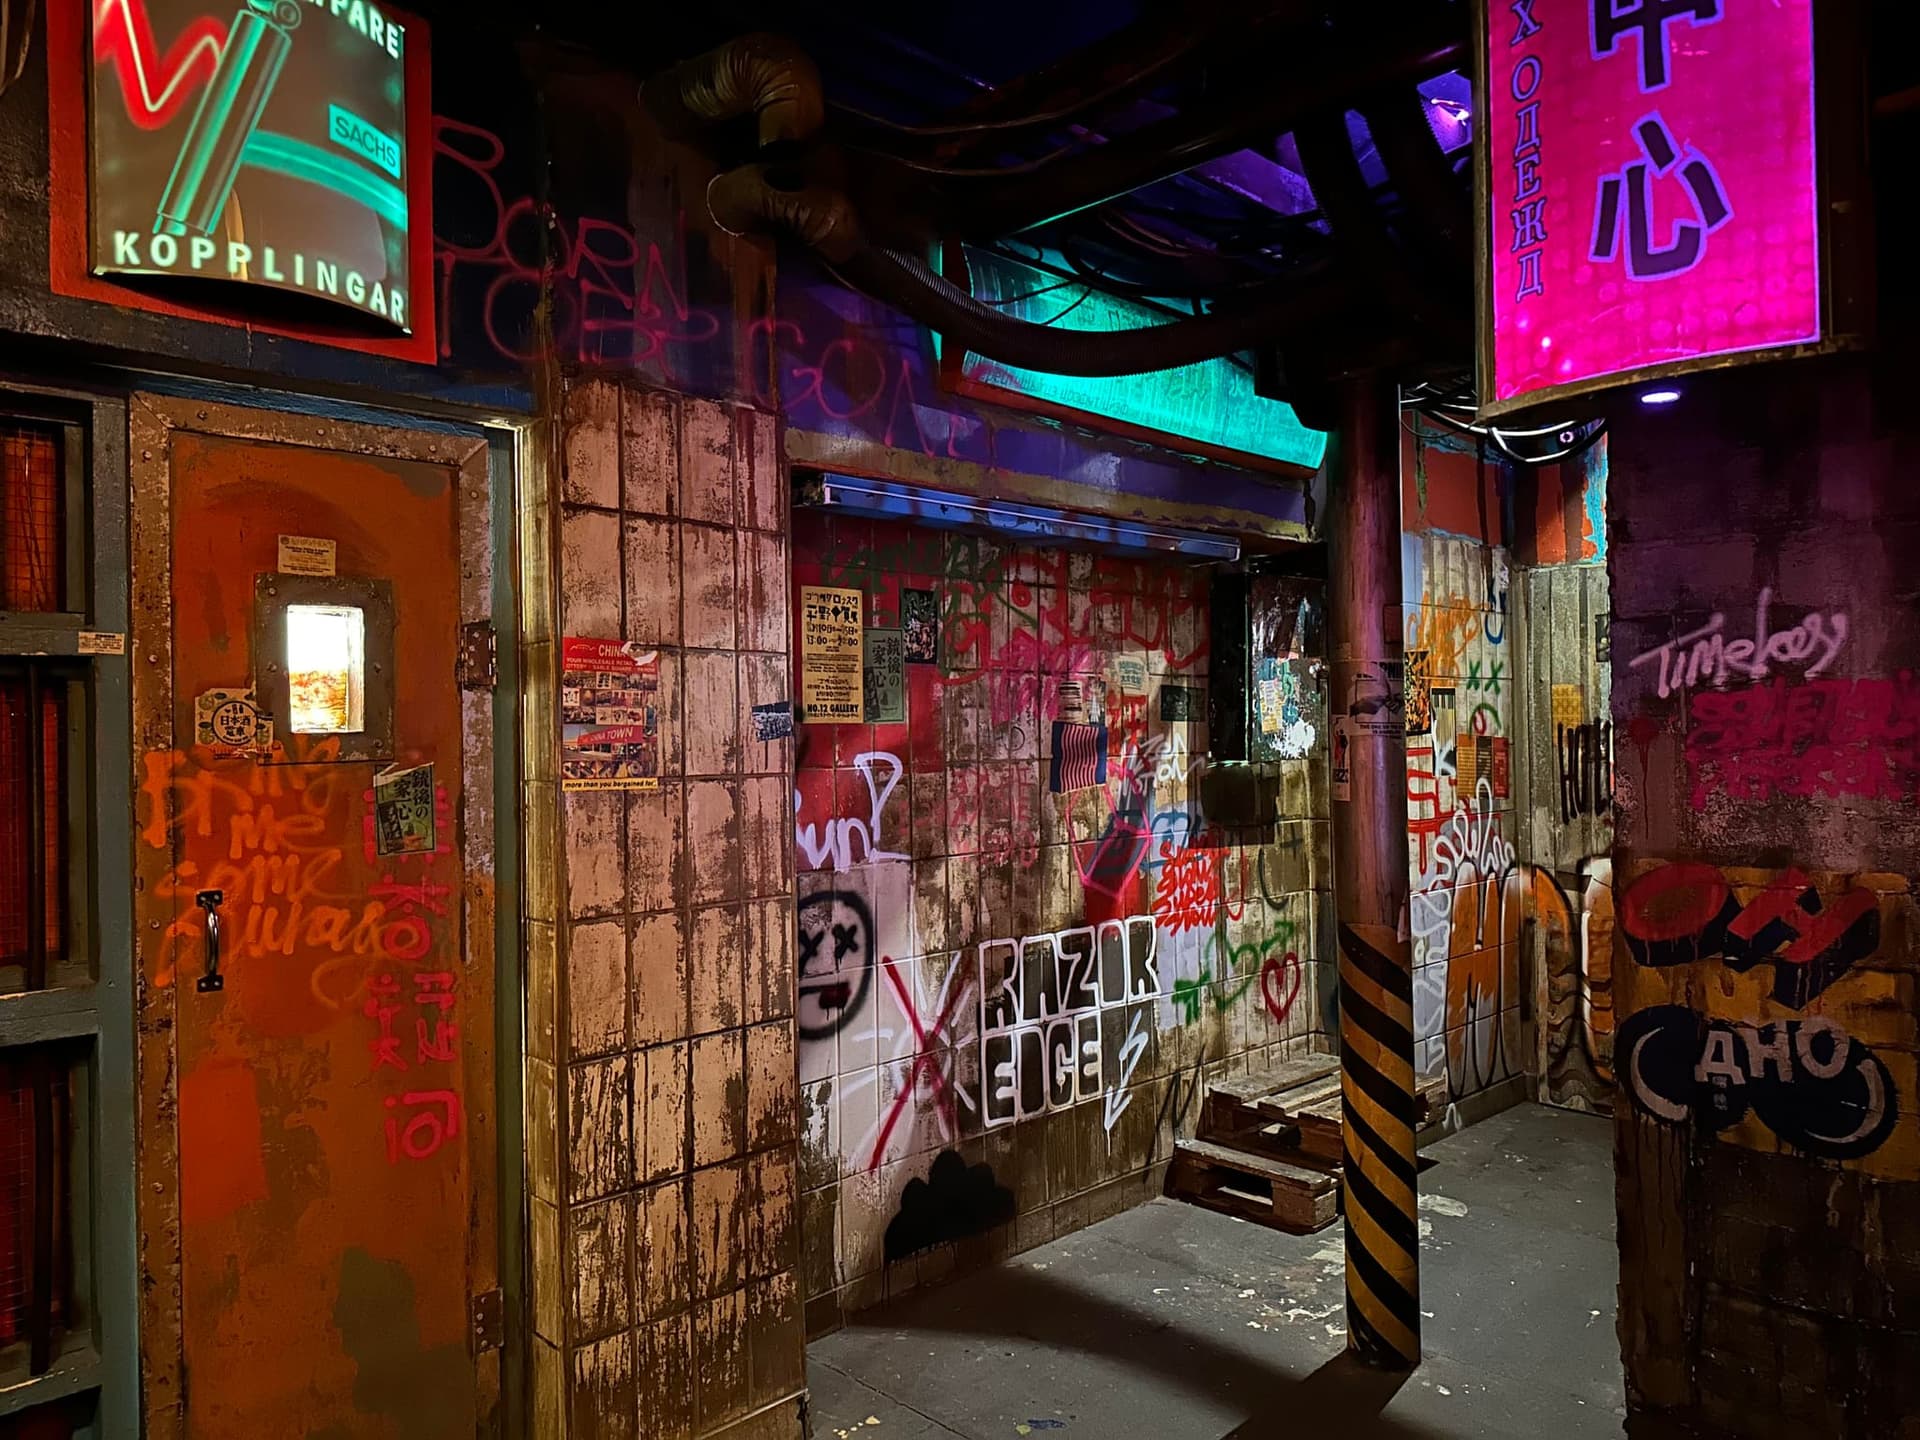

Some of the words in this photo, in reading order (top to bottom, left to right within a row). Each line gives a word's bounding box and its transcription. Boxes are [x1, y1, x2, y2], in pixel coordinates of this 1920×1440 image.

[308, 0, 400, 60] PARE
[334, 115, 398, 169] SACHS
[112, 229, 407, 325] KOPPLINGAR
[607, 726, 634, 740] TOWN
[830, 703, 859, 714] GALLERY
[600, 781, 612, 789] you
[978, 915, 1163, 1037] RAZOR
